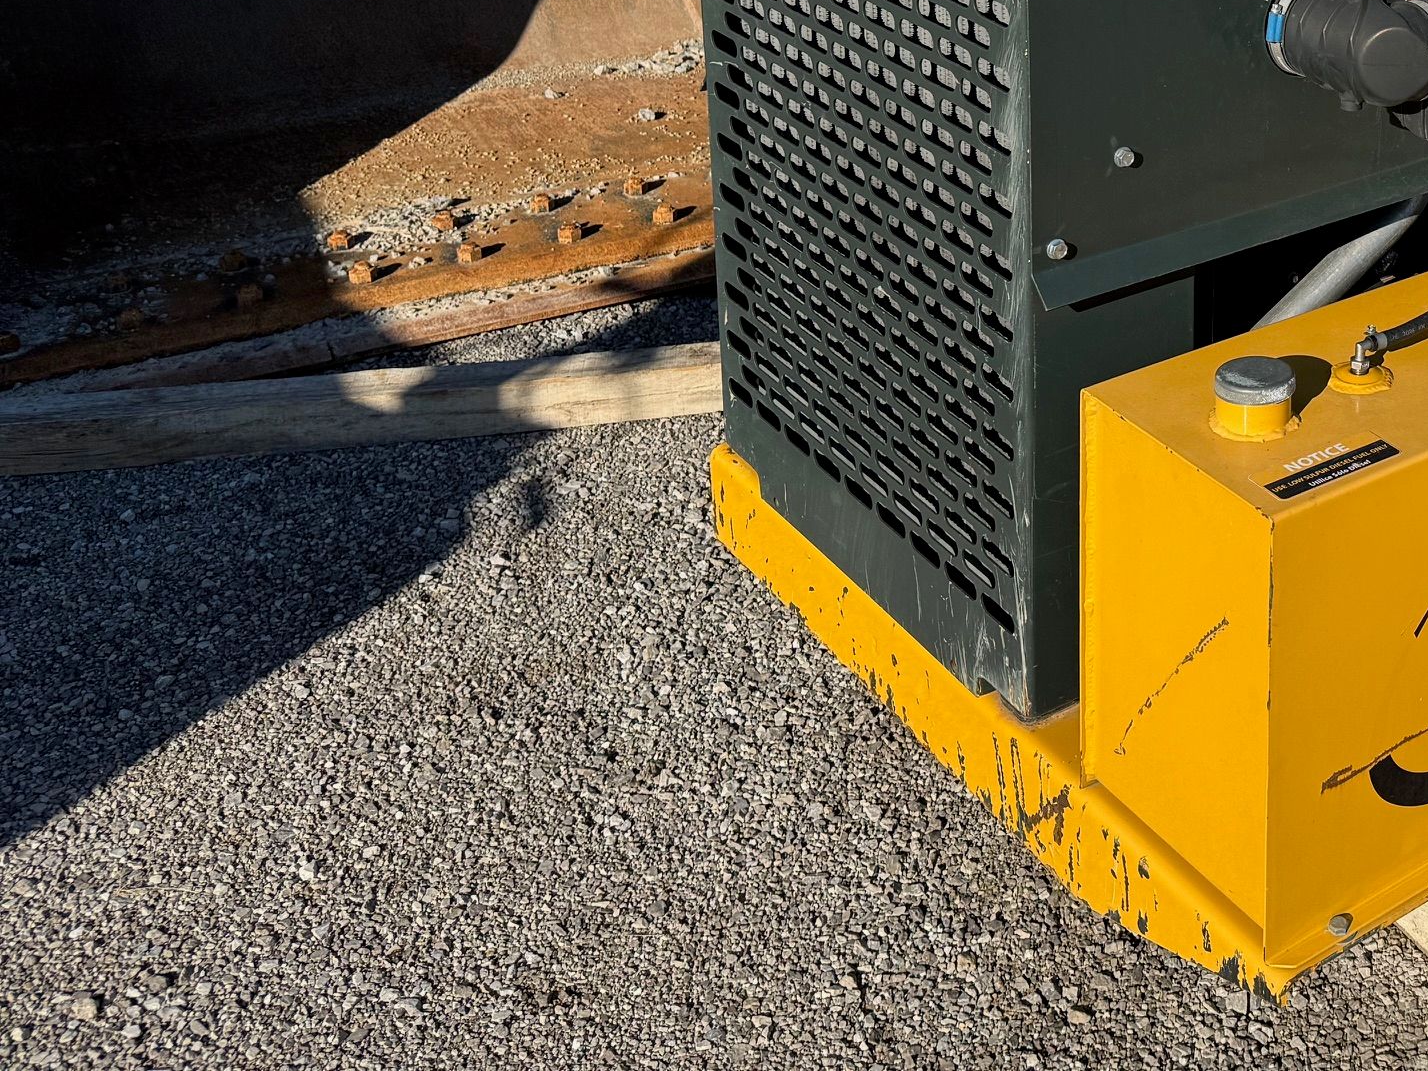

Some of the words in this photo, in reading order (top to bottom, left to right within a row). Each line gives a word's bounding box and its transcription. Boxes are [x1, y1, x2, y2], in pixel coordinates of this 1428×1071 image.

[1272, 484, 1288, 493] USE
[1288, 477, 1305, 487] LOW
[1328, 458, 1354, 470] DIESEL
[1353, 451, 1371, 461] FUEL
[1369, 443, 1388, 454] ONLY
[1283, 443, 1350, 472] NOTICE
